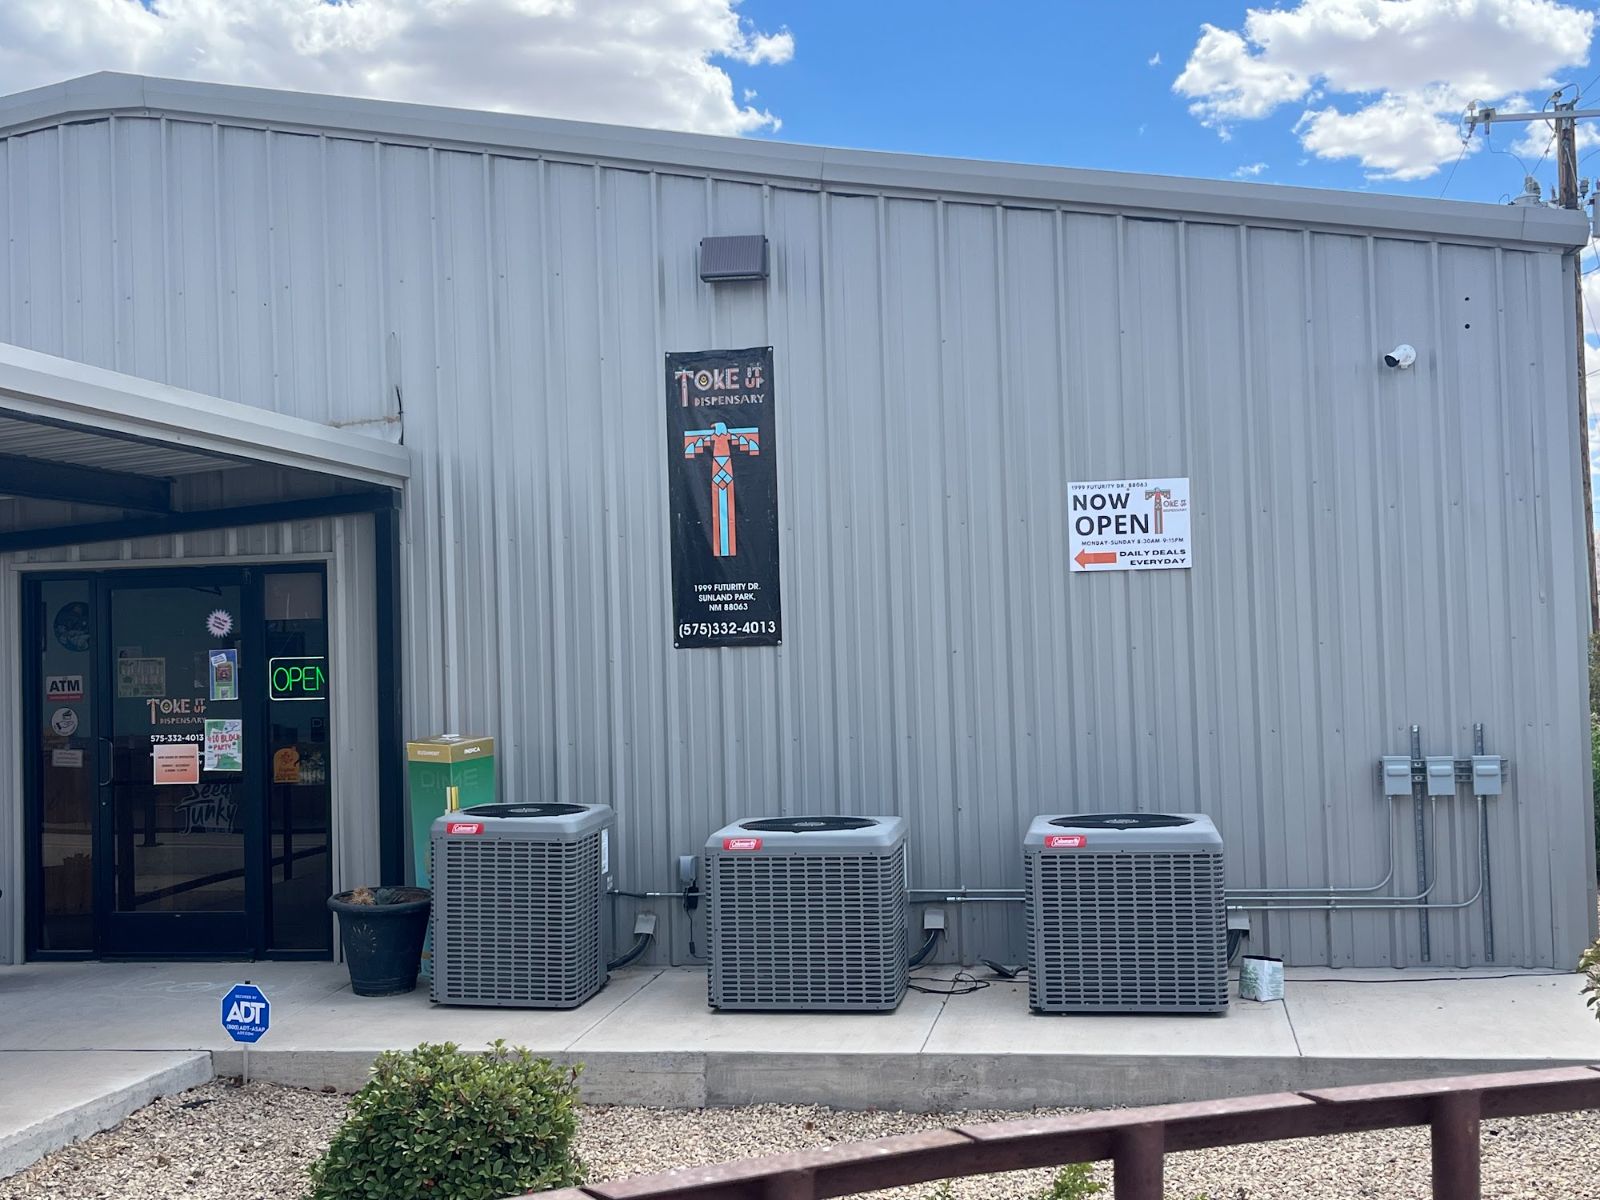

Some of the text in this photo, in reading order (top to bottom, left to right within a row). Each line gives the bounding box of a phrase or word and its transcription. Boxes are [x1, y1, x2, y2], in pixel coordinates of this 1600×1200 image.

[745, 377, 765, 389] UP
[694, 394, 765, 407] DISPENSARY
[1073, 493, 1130, 511] NOW
[1075, 514, 1149, 536] OPEN
[1130, 558, 1186, 566] EVERYDAY
[694, 582, 761, 592] 1999 FUTURITY DR.
[698, 593, 756, 602] SUNLAND PARK,
[724, 603, 748, 611] 88063
[679, 621, 776, 638] (575)332-4013
[49, 679, 81, 693] ATM
[150, 734, 204, 742] 575-332-4013
[226, 1001, 266, 1024] ADT
